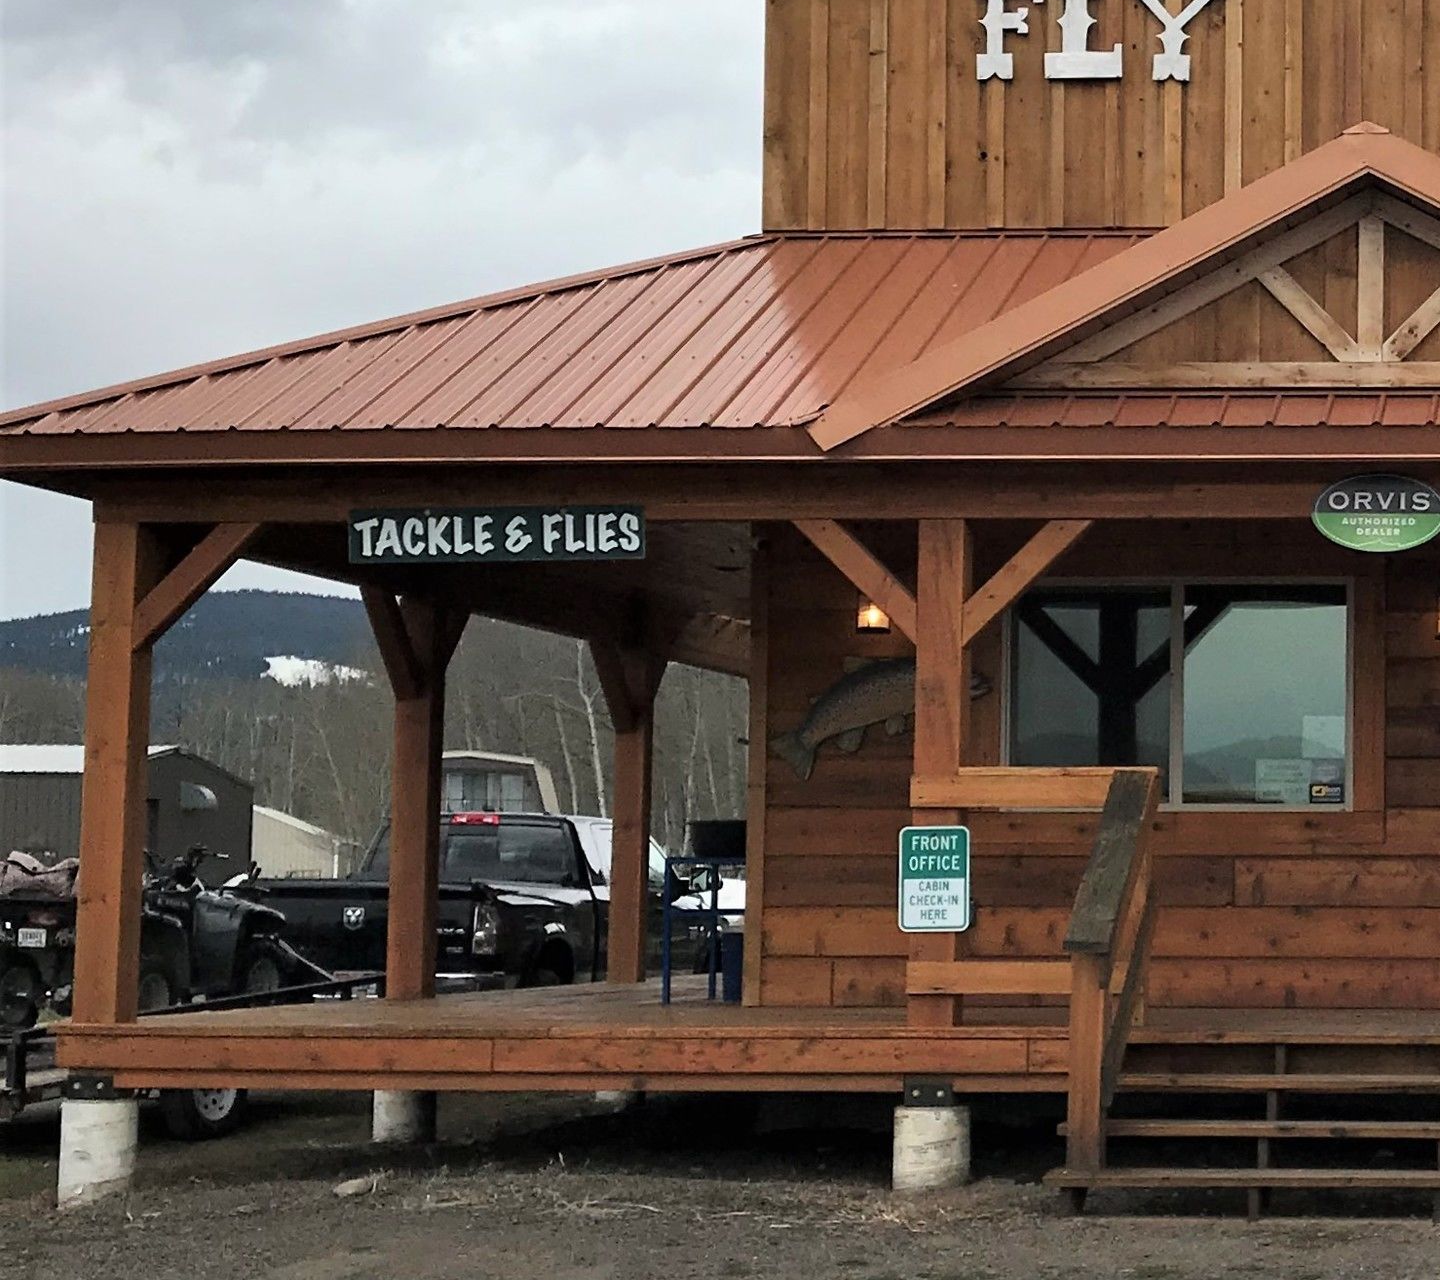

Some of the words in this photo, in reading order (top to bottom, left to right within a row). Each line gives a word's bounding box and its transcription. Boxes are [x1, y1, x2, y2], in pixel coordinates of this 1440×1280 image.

[1328, 491, 1431, 511] ORVIS
[1341, 517, 1416, 526] AUTHORIZED
[353, 515, 495, 557] TACKLE
[504, 516, 533, 554] &
[542, 513, 641, 554] FLIES
[1356, 528, 1400, 536] DEALER
[911, 835, 958, 851] FRONT
[908, 855, 960, 871] OFFICE
[919, 881, 950, 892] CABIN
[909, 895, 959, 906] CHECK-IN
[920, 909, 947, 920] HERE
